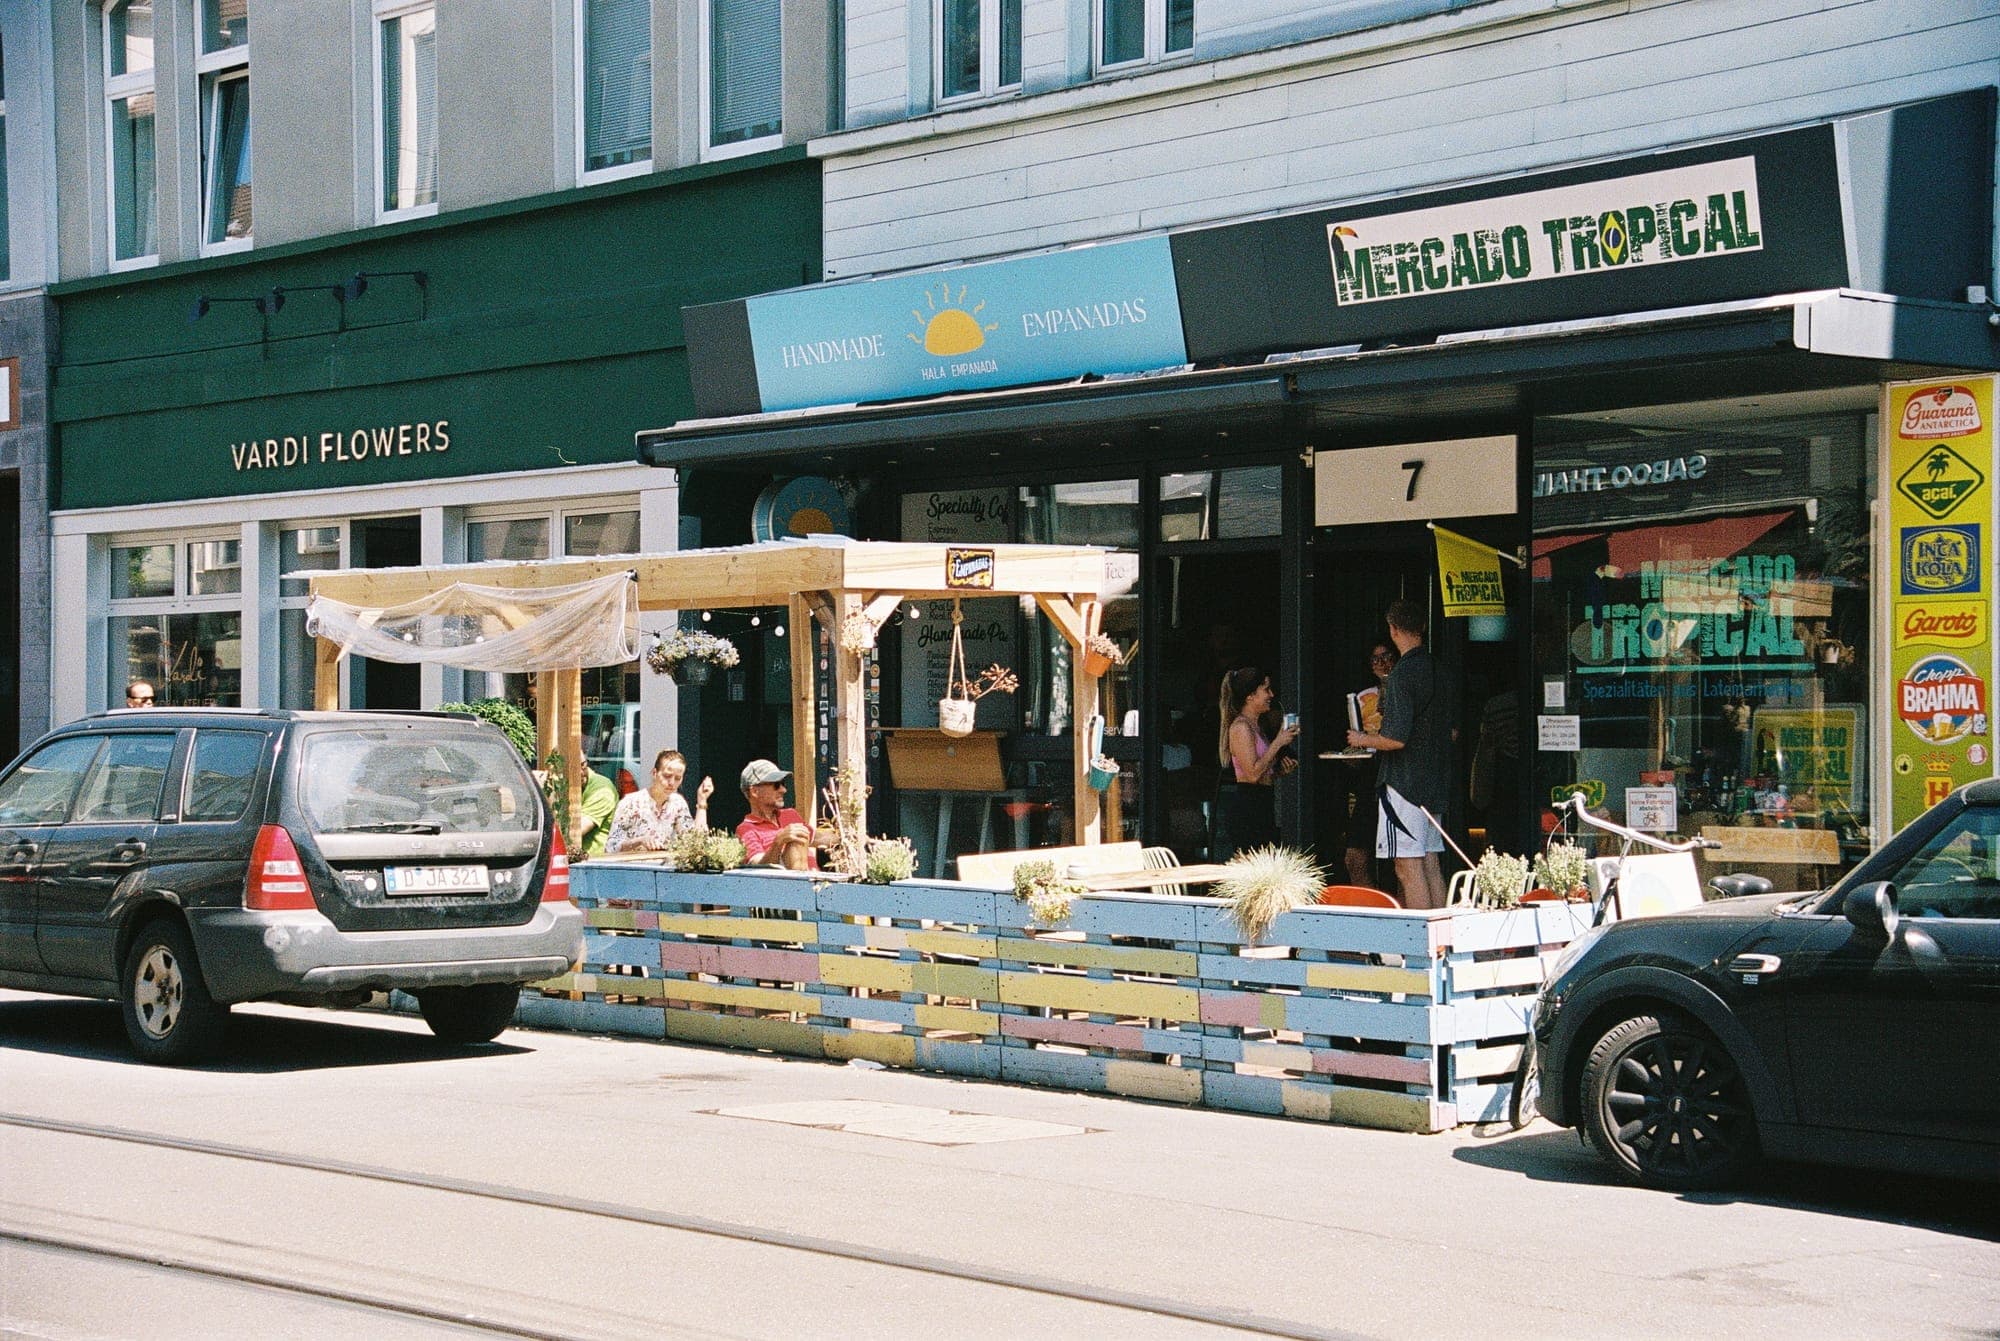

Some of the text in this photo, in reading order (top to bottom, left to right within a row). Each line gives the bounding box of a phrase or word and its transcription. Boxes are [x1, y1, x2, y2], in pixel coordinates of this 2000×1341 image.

[1337, 190, 1761, 302] MERCADO TROPICAL
[1022, 299, 1147, 337] EMPANADAS
[782, 334, 886, 369] HANDMADE
[921, 360, 998, 381] HALA EMPANADA
[1905, 400, 1975, 429] Guaraná
[1920, 418, 1975, 430] ANTARCTICA
[231, 420, 450, 471] VARDI FLOWERS
[1401, 461, 1424, 501] 7
[926, 493, 986, 523] Specialty
[1918, 541, 1961, 558] INCA
[1460, 570, 1499, 583] MERCADO
[1639, 554, 1797, 599] MERCADO
[1916, 561, 1964, 576] KOLA
[1446, 584, 1504, 602] TROPICAL
[917, 623, 986, 648] Handade
[1585, 601, 1806, 661] TROPICAL
[1903, 607, 1977, 637] Garoto
[1913, 667, 1966, 683] Chopp
[1903, 684, 1980, 713] BRAHMA
[427, 868, 447, 887] JA
[451, 867, 481, 886] 321
